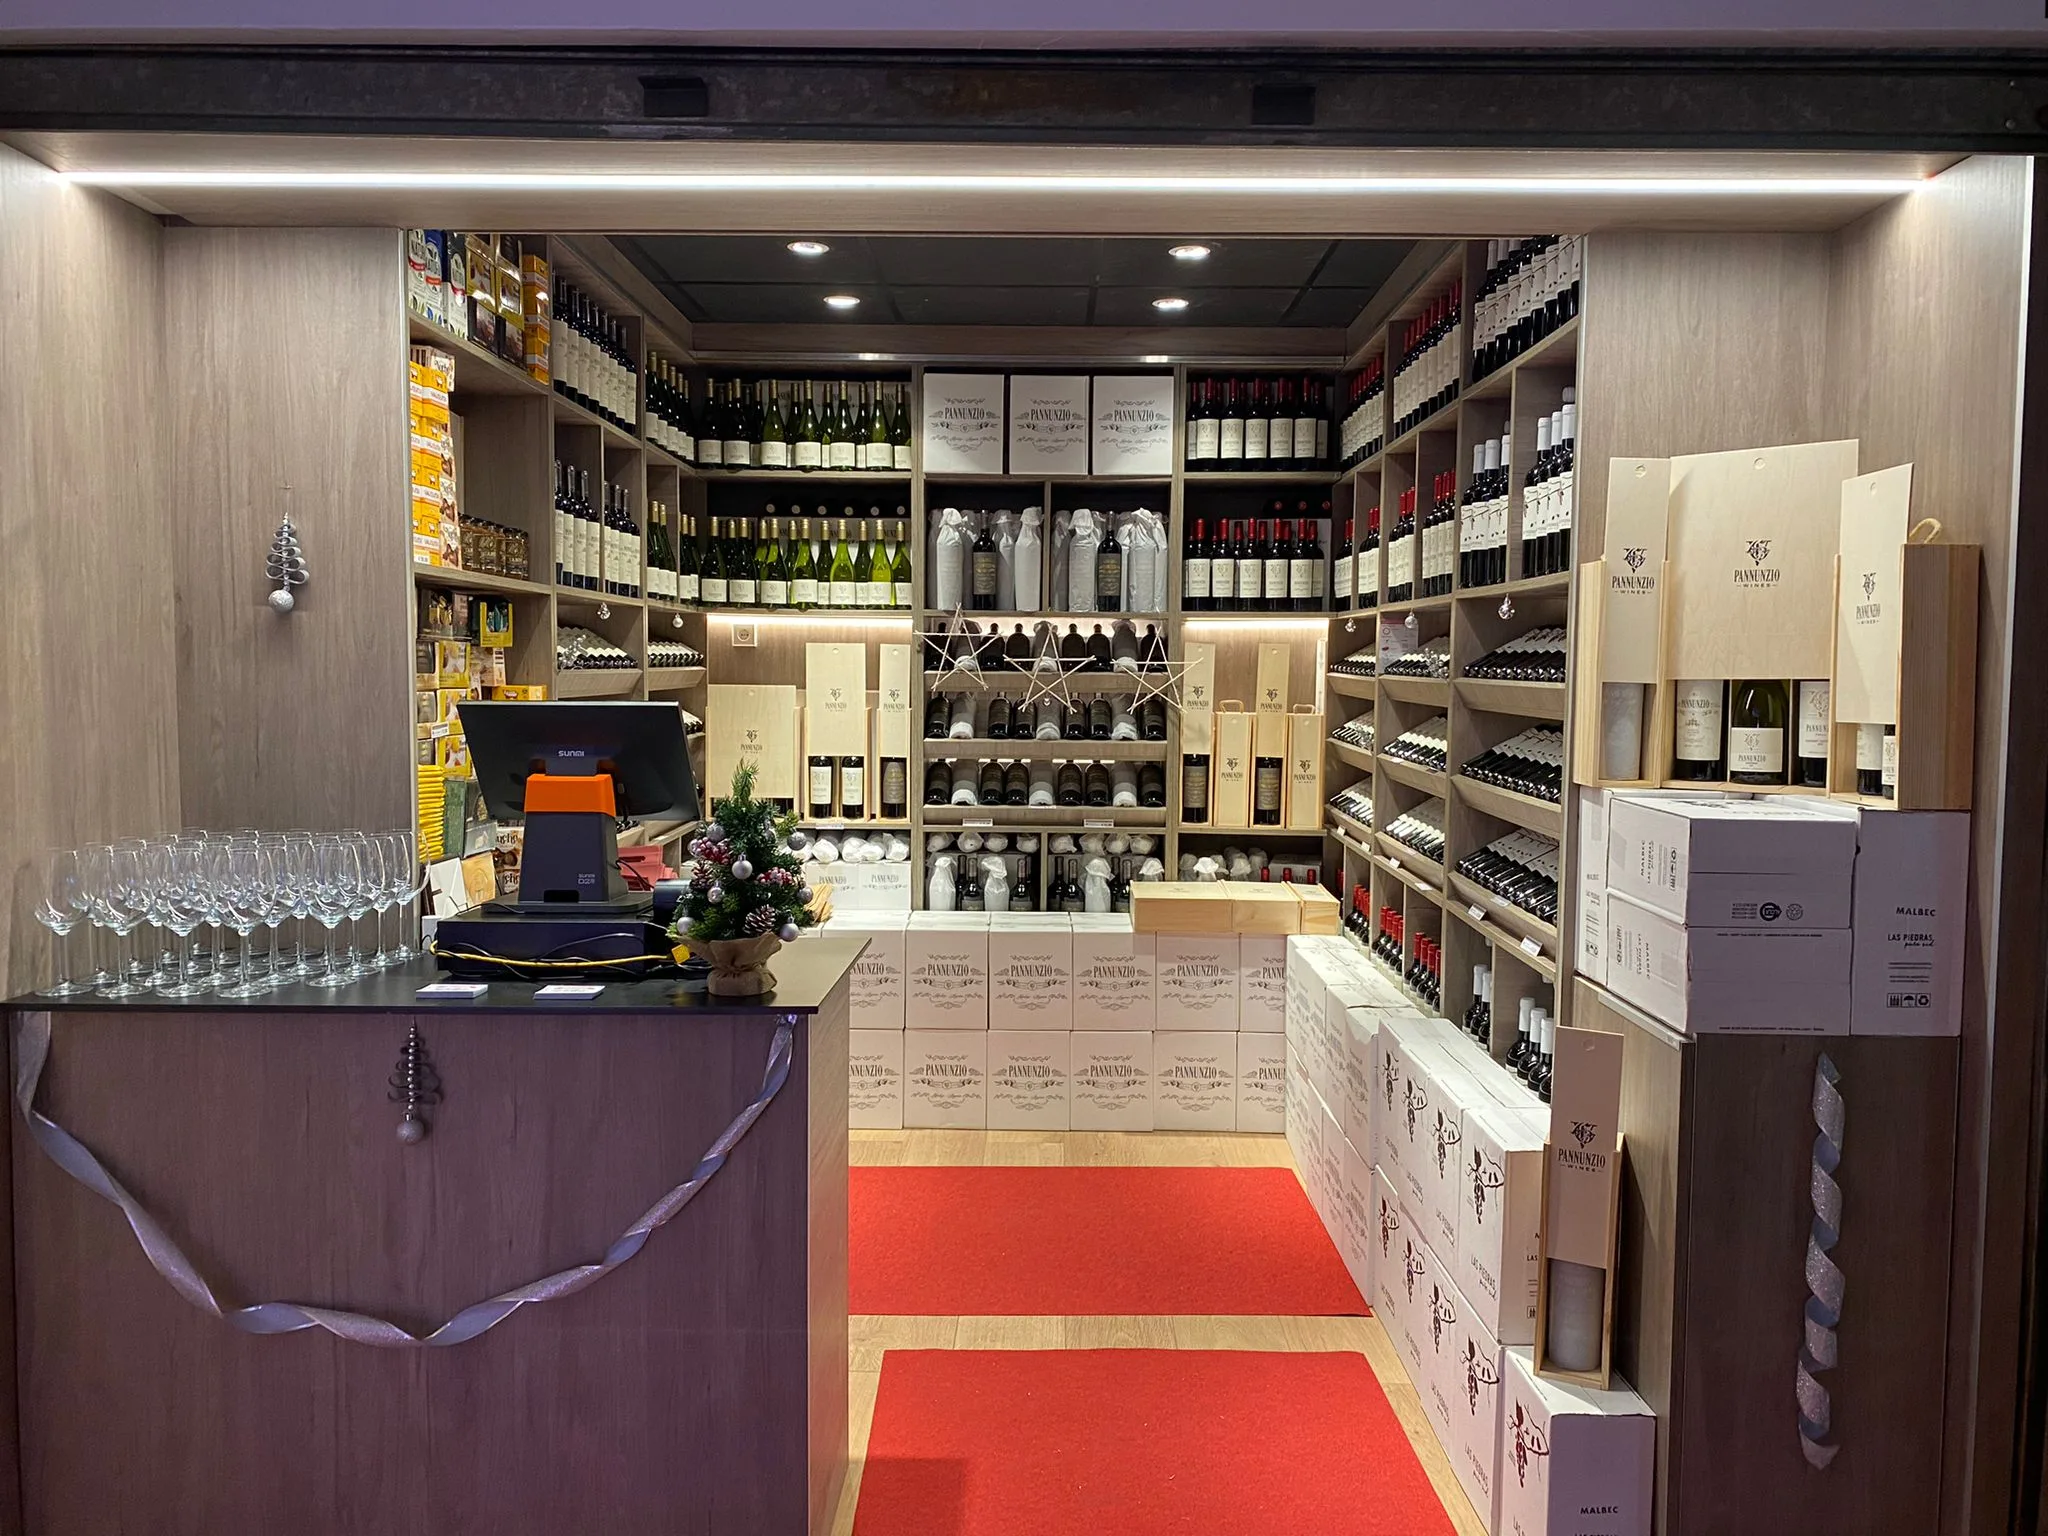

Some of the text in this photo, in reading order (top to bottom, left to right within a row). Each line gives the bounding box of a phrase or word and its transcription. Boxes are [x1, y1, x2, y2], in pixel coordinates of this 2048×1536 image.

[944, 407, 985, 421] PANNUNZIO
[1030, 408, 1071, 421] PANNUNZIO
[1114, 409, 1154, 422] PANNUNZIO
[1734, 568, 1780, 582] PANNUNZIO
[1612, 576, 1655, 589] PANNUNZIO
[1856, 603, 1881, 619] PANNUNZIO
[1896, 907, 1936, 917] MALBEC
[1887, 933, 1901, 942] LAS
[851, 963, 884, 976] NNUNZIO
[927, 963, 969, 976] PANNUNZIO
[1010, 964, 1053, 977] PANNUNZIO
[1093, 965, 1135, 978] PANNUNZIO
[1177, 964, 1219, 977] PANNUNZIO
[1262, 967, 1285, 979] PANNU
[850, 1064, 883, 1077] NNUNZIO
[925, 1063, 967, 1077] PANNUNZIO
[1008, 1064, 1050, 1078] PANNUNZIO
[1090, 1064, 1132, 1078] PANNUNZIO
[1175, 1066, 1217, 1080] PANNUNZIO
[1259, 1067, 1285, 1080] PANNU
[1558, 1148, 1606, 1168] PANNUNZIO
[1471, 1253, 1479, 1270] LAS
[1526, 1254, 1538, 1262] LAS
[1464, 1441, 1473, 1461] LAS
[1580, 1506, 1618, 1514] MALBEC
